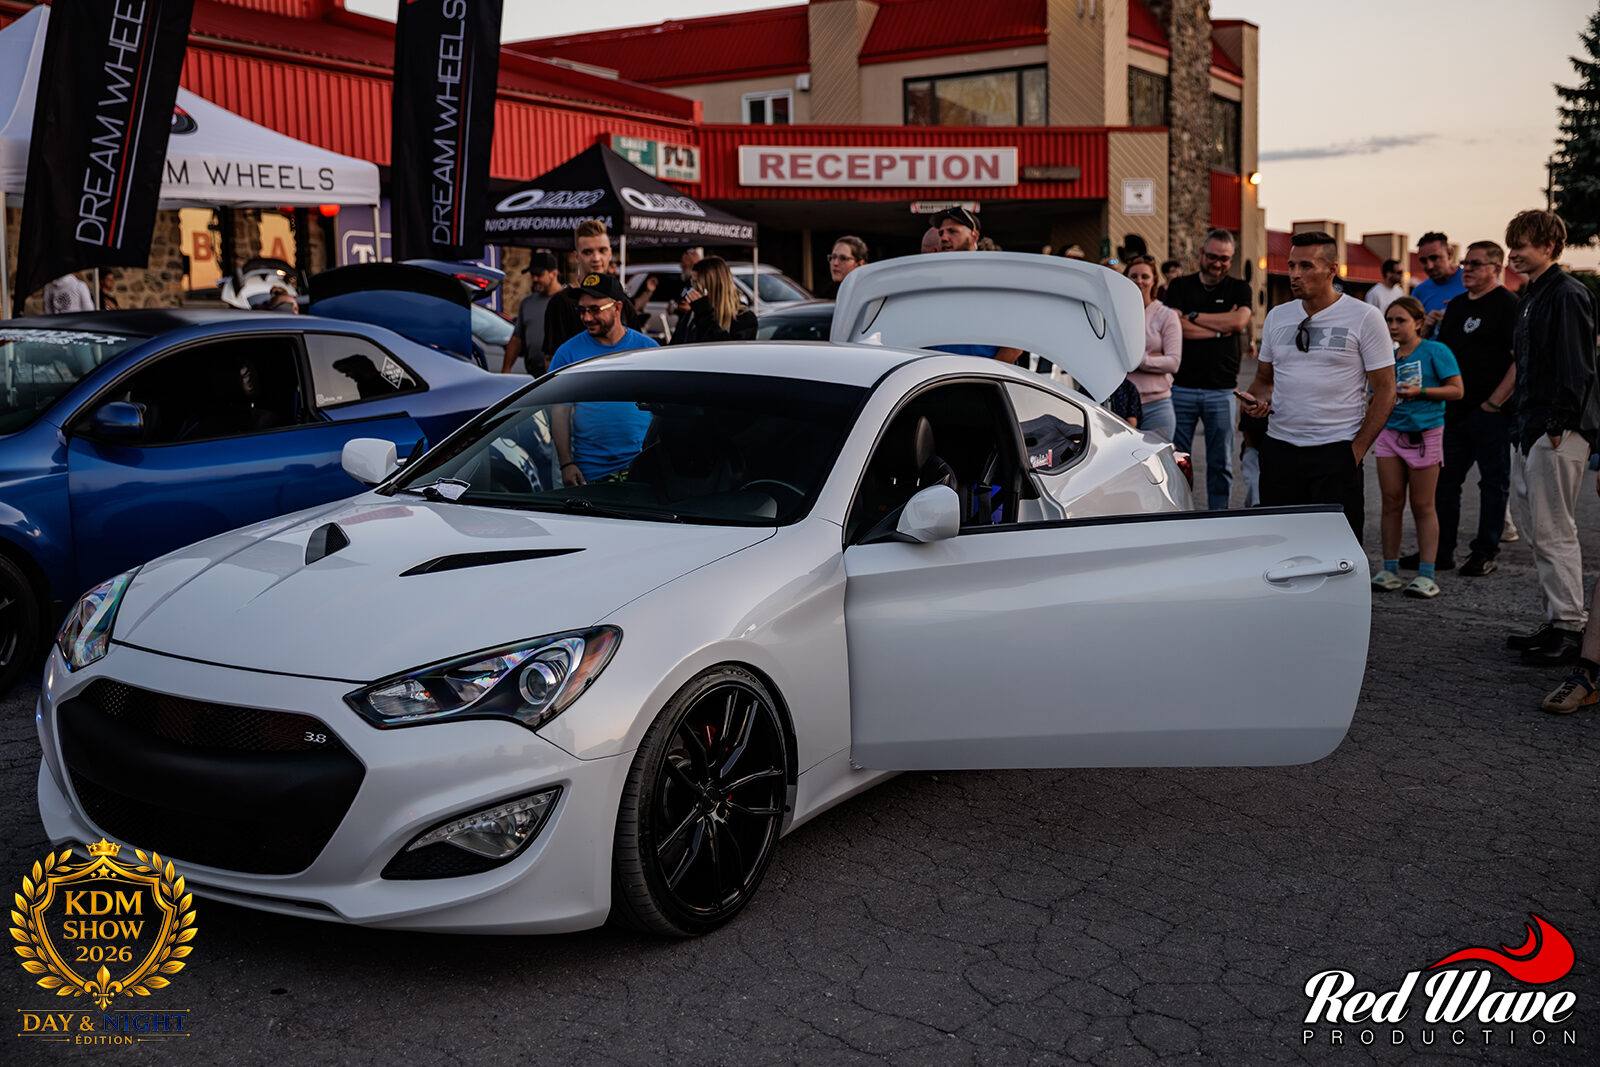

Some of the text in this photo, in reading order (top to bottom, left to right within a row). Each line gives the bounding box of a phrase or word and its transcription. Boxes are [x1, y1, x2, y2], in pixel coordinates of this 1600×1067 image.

[431, 0, 467, 245] DREAM WHEELS
[75, 115, 125, 246] DREAM
[203, 160, 335, 191] WHEELS
[759, 153, 1000, 180] RECEPTION
[192, 232, 213, 261] B
[271, 237, 288, 263] A
[303, 731, 327, 744] 3.8
